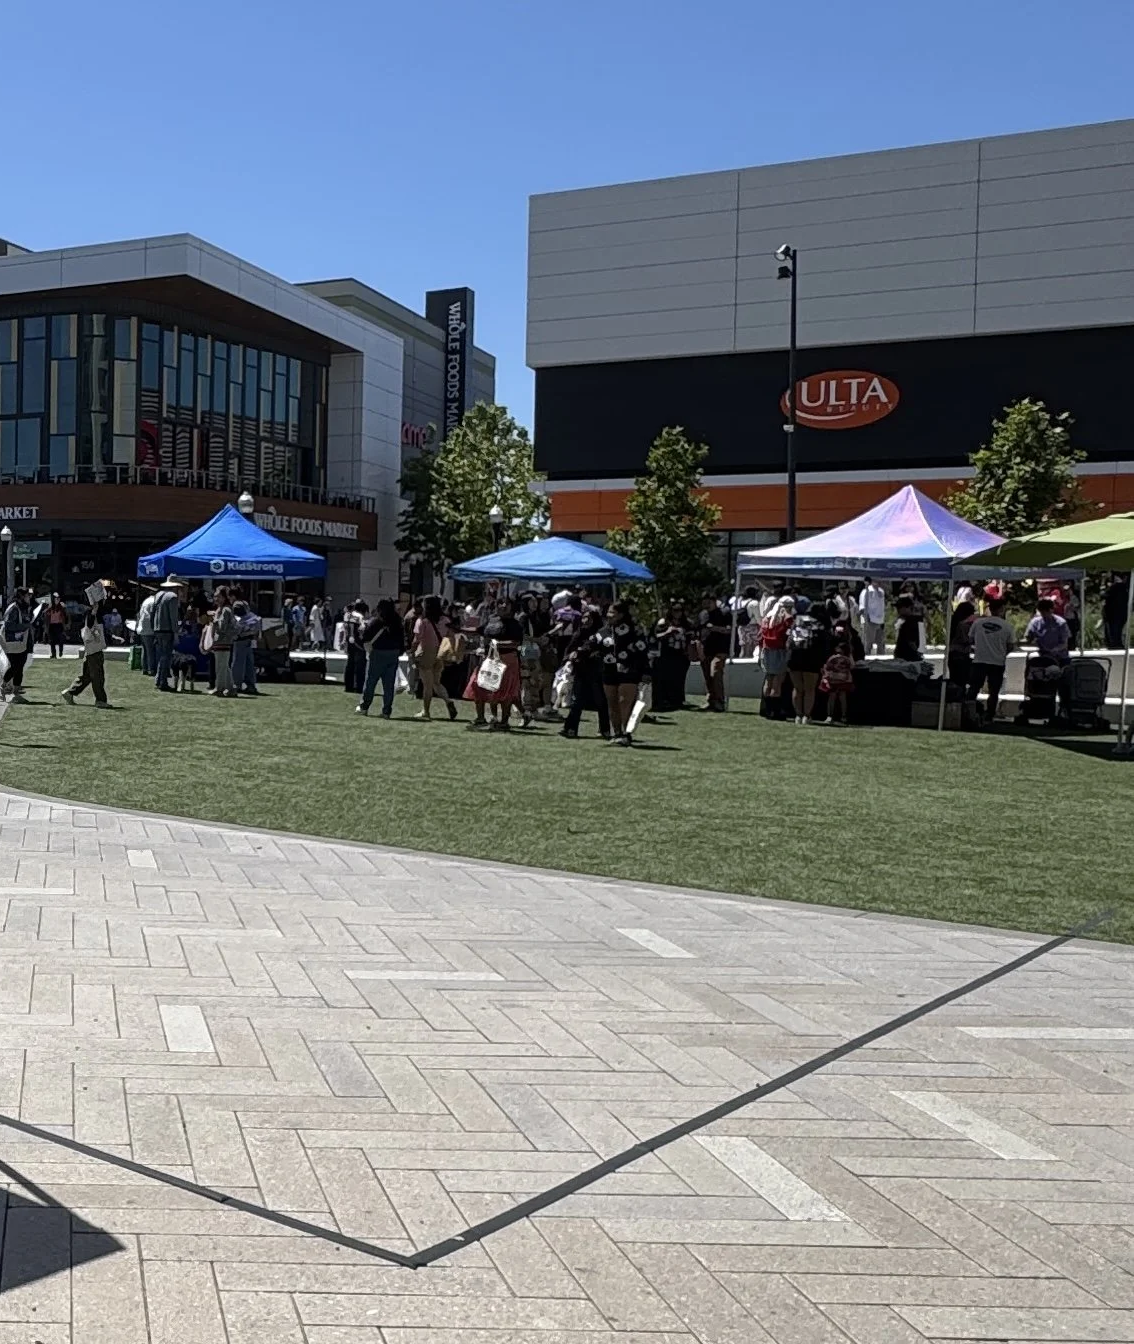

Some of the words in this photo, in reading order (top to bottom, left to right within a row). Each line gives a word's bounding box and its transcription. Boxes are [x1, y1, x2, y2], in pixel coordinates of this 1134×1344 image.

[447, 302, 466, 351] WHOLE
[447, 354, 460, 399] FOODS
[801, 377, 888, 407] ULTA
[253, 506, 290, 532] WHOLE
[291, 517, 322, 536] FOODS
[227, 562, 284, 573] KidStrong
